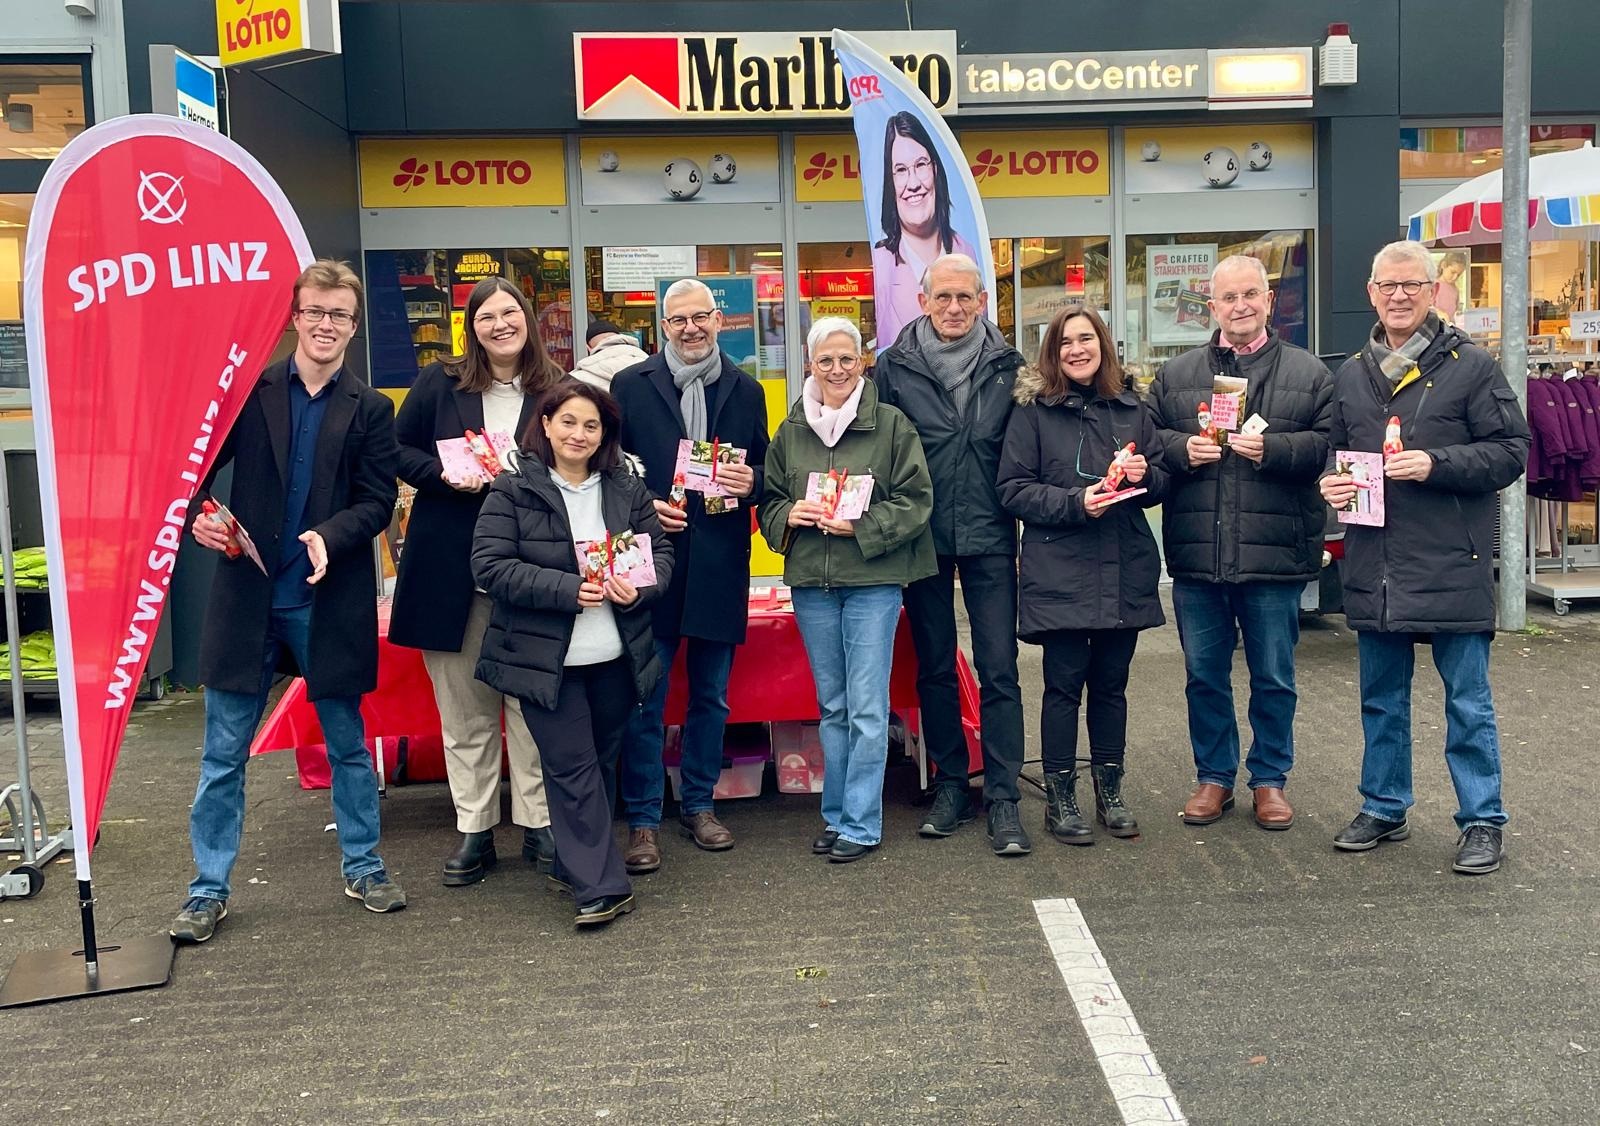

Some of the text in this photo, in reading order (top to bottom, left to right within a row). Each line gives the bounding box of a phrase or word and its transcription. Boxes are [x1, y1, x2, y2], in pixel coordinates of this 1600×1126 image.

[225, 8, 291, 51] LOTTO
[684, 37, 952, 112] Marlbro
[966, 58, 1199, 93] tabaCCenter
[435, 160, 532, 185] LOTTO
[1009, 150, 1099, 175] LOTTO
[455, 262, 498, 273] JACKPOT
[1170, 254, 1209, 264] CRAFTED
[67, 241, 270, 312] SPD LINZ
[766, 281, 784, 294] Wins
[827, 280, 859, 293] Winston
[827, 306, 854, 314] LOTTO
